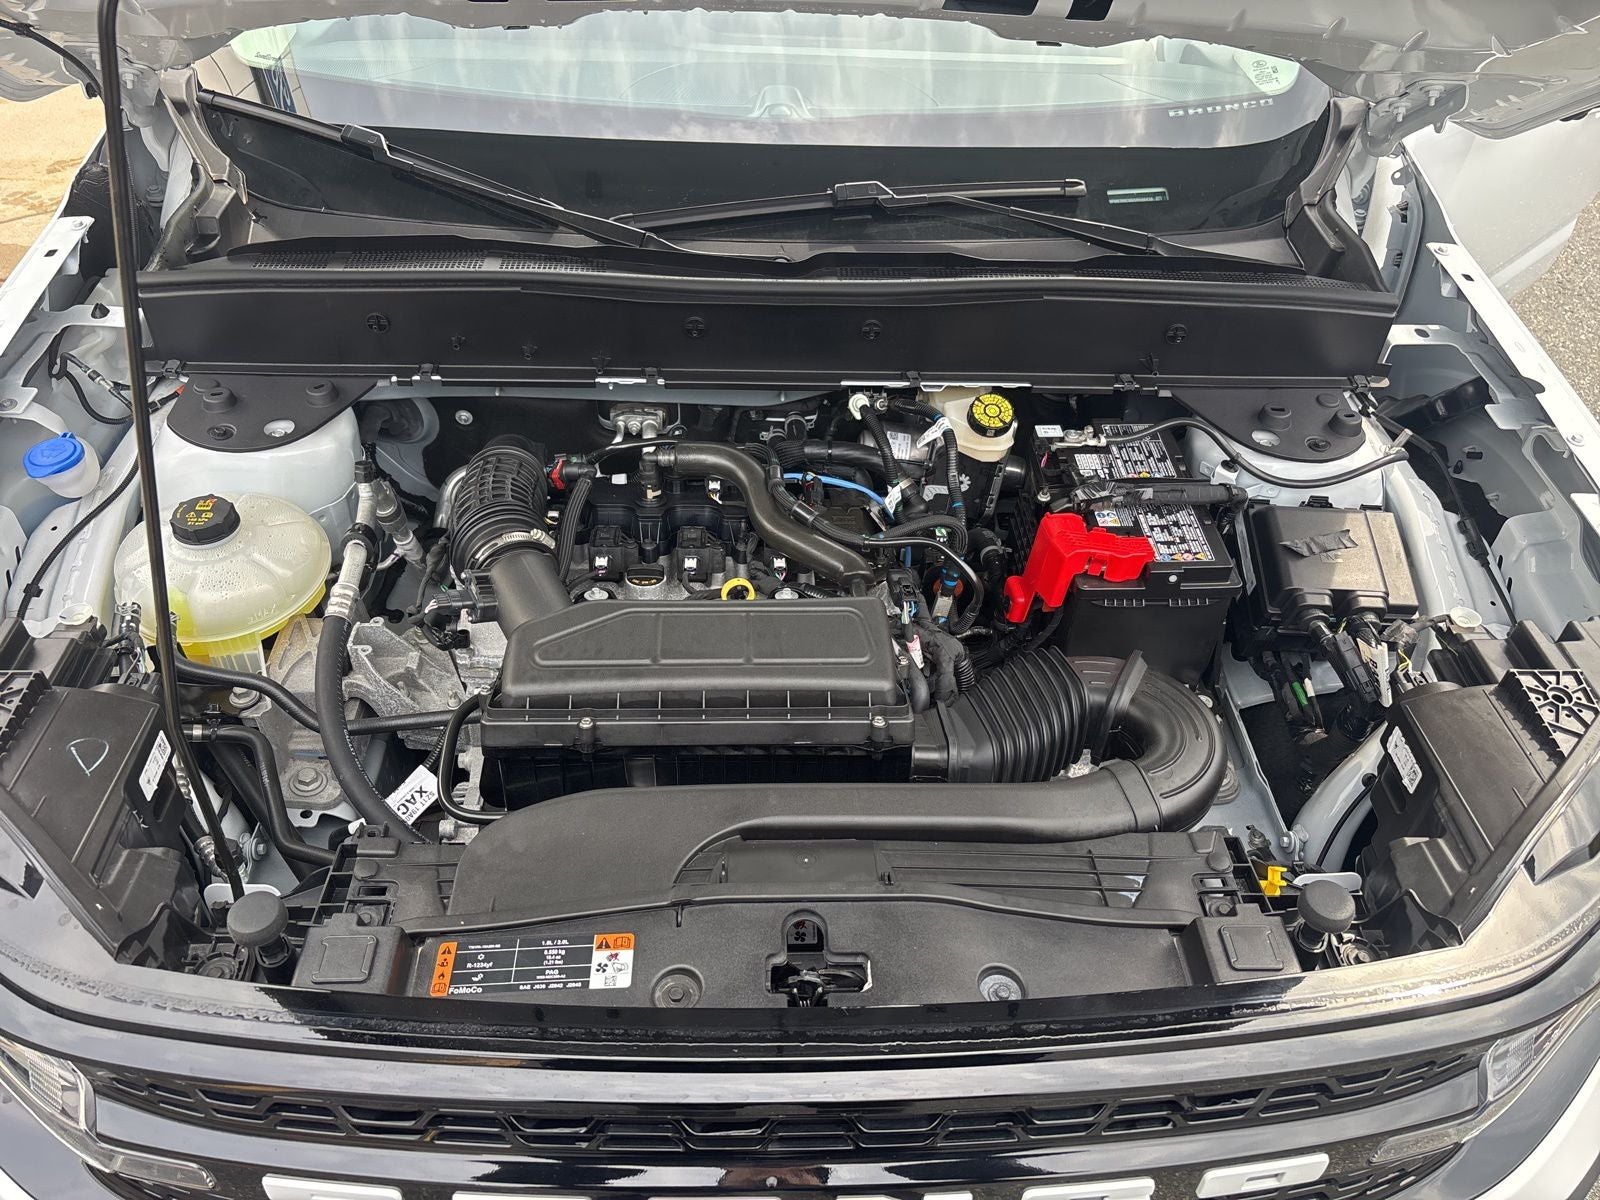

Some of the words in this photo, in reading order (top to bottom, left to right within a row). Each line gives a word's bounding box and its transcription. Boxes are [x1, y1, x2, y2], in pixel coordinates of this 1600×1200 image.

[397, 785, 429, 815] XAC
[466, 961, 493, 969] R-1234yf
[448, 986, 483, 995] FoMoCo
